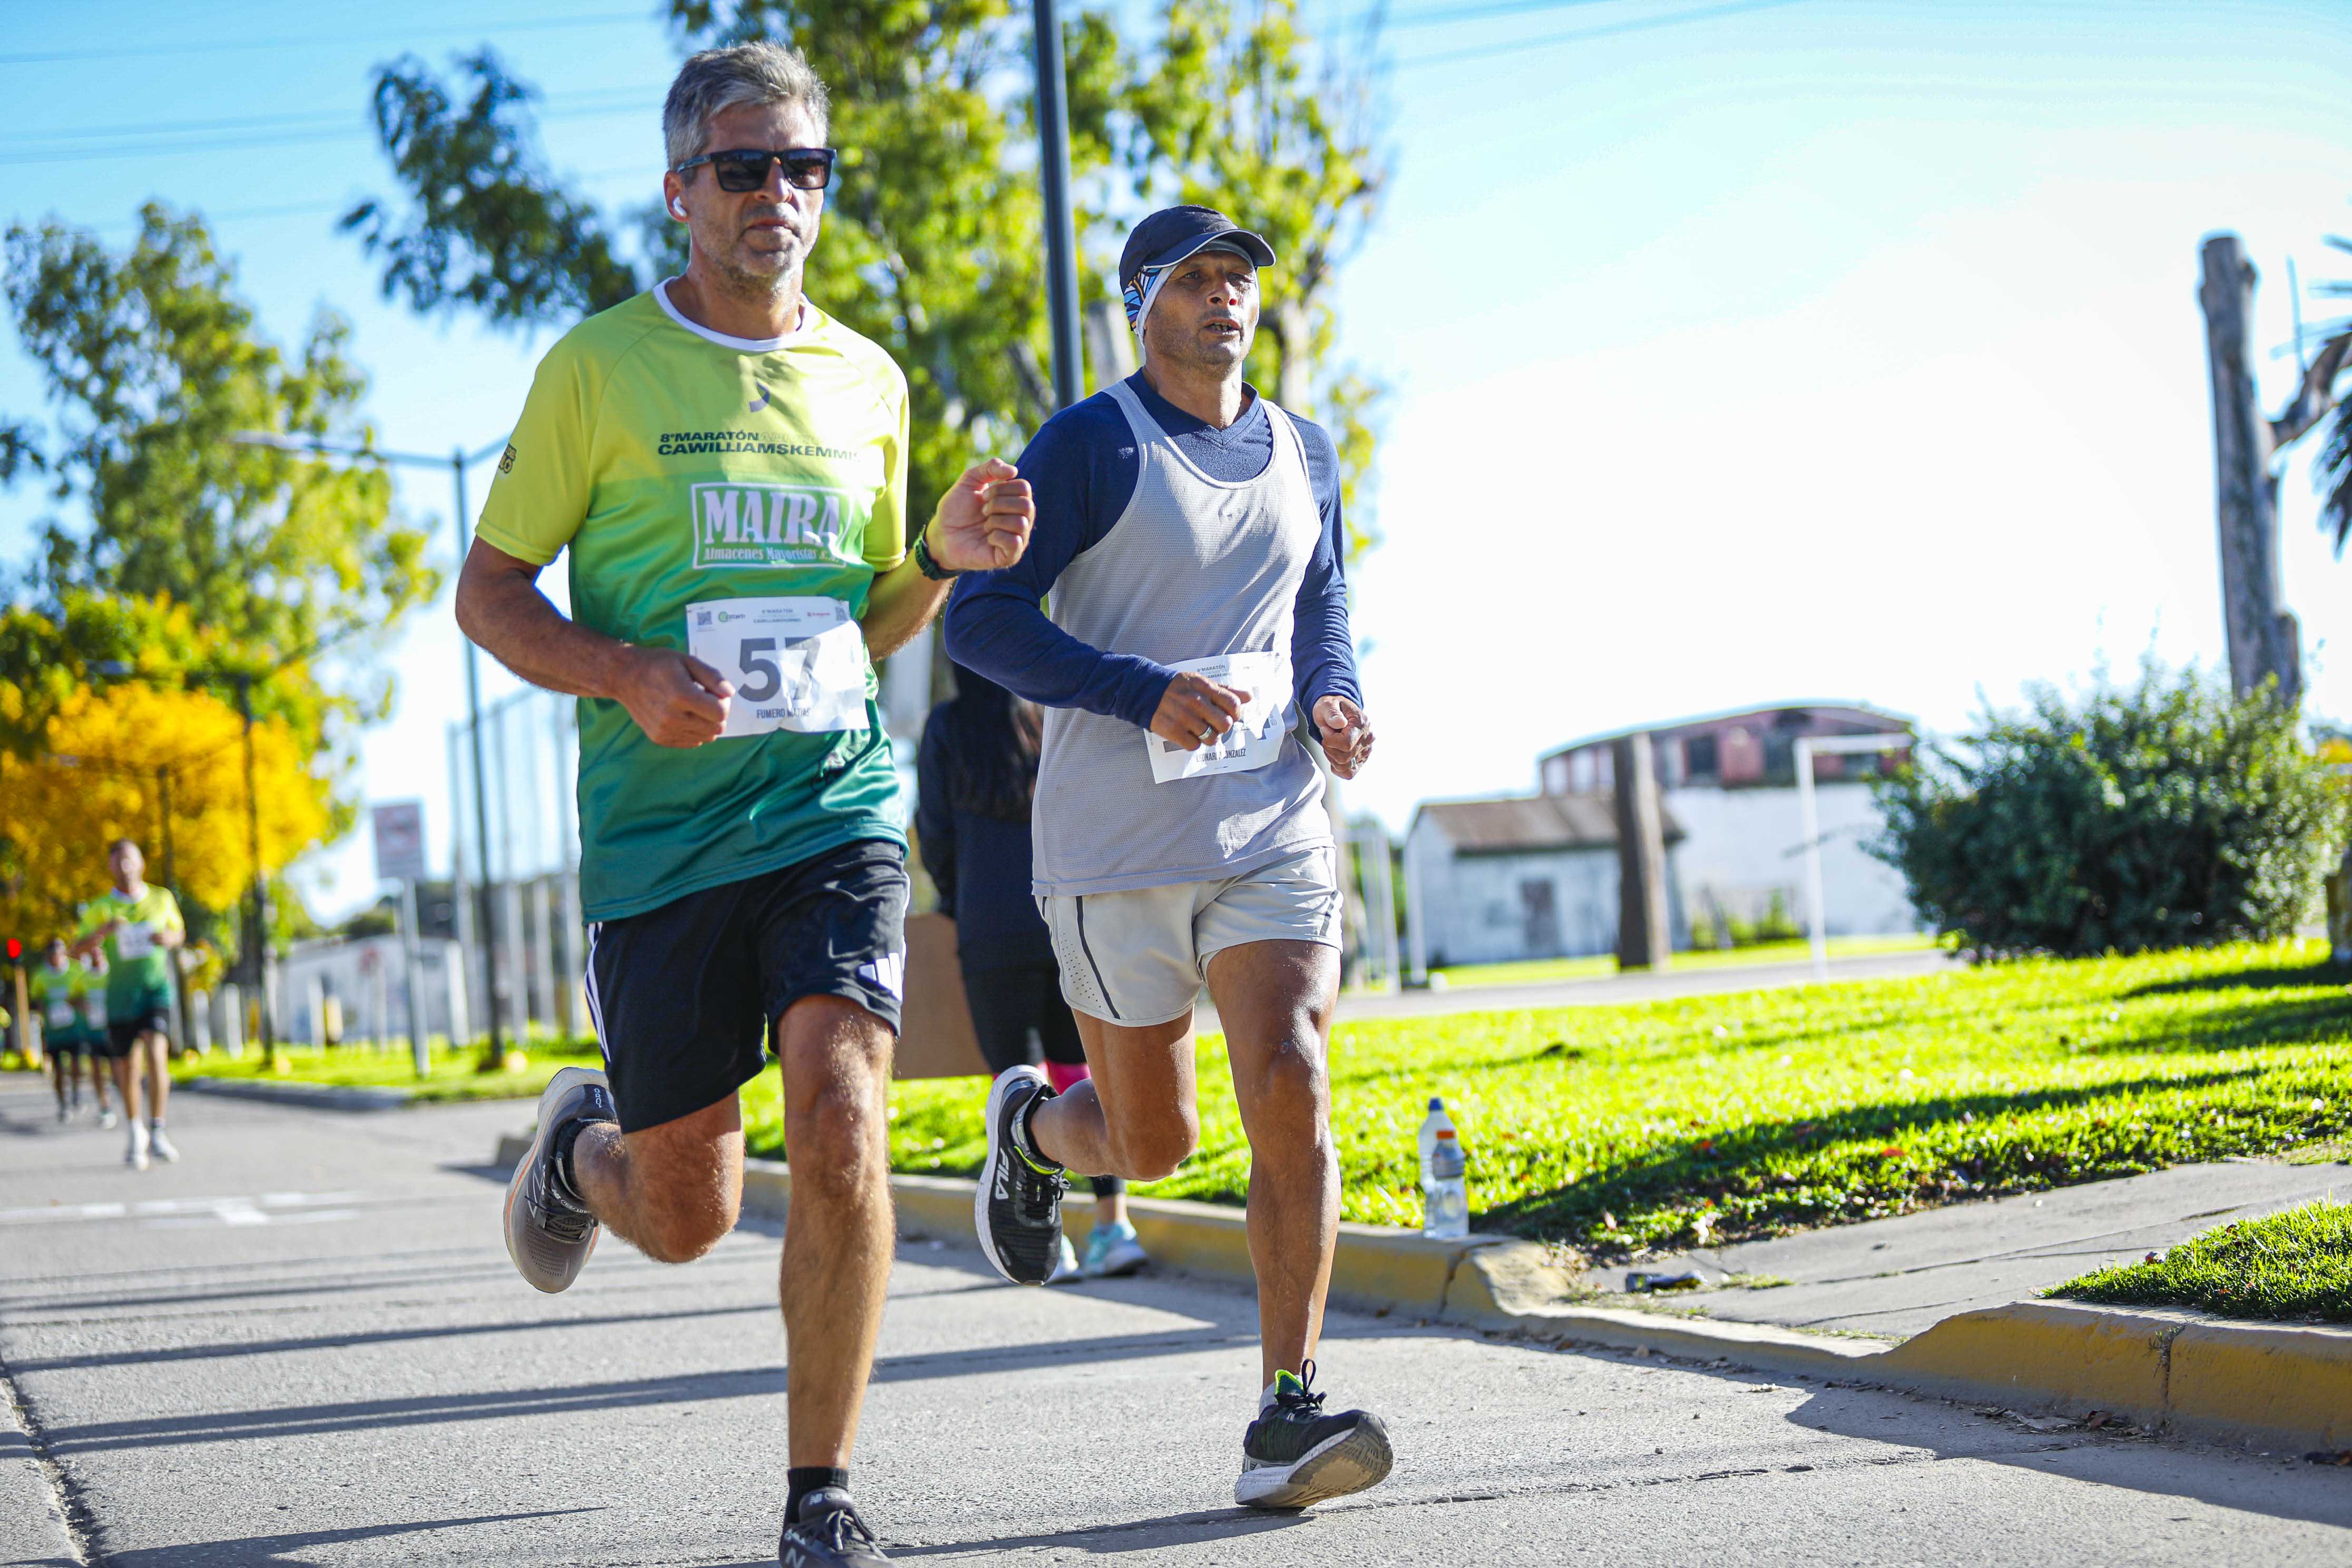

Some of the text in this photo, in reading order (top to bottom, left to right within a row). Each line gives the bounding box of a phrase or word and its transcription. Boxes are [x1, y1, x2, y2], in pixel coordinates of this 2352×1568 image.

[703, 490, 840, 546] MAIRA
[704, 547, 763, 561] Almacenes
[767, 547, 817, 562] Mayoristas
[738, 636, 820, 702] 57
[757, 708, 785, 718] FUMERO
[1223, 748, 1247, 759] ONZALEZ
[996, 1148, 1009, 1199] FILA
